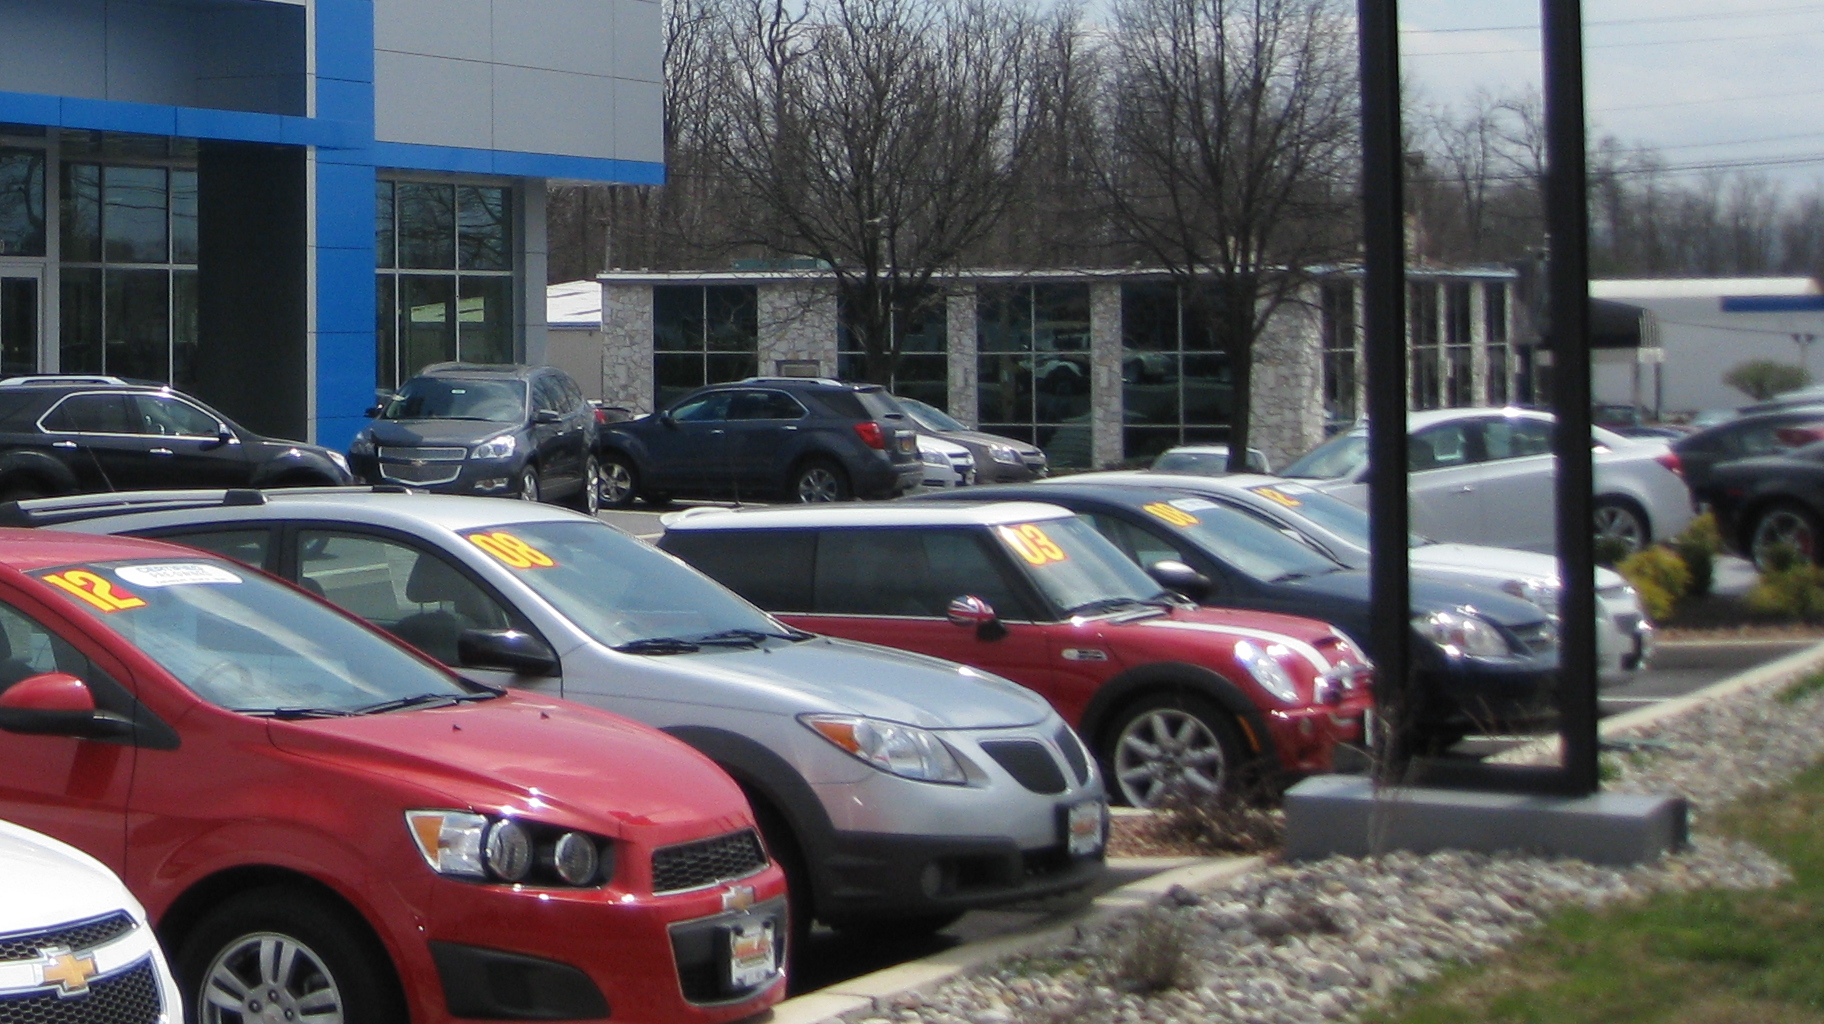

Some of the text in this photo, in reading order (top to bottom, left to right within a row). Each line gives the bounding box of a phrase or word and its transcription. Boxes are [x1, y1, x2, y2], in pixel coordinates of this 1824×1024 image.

[468, 531, 554, 569] 08
[997, 523, 1066, 566] 03
[43, 570, 147, 613] 12
